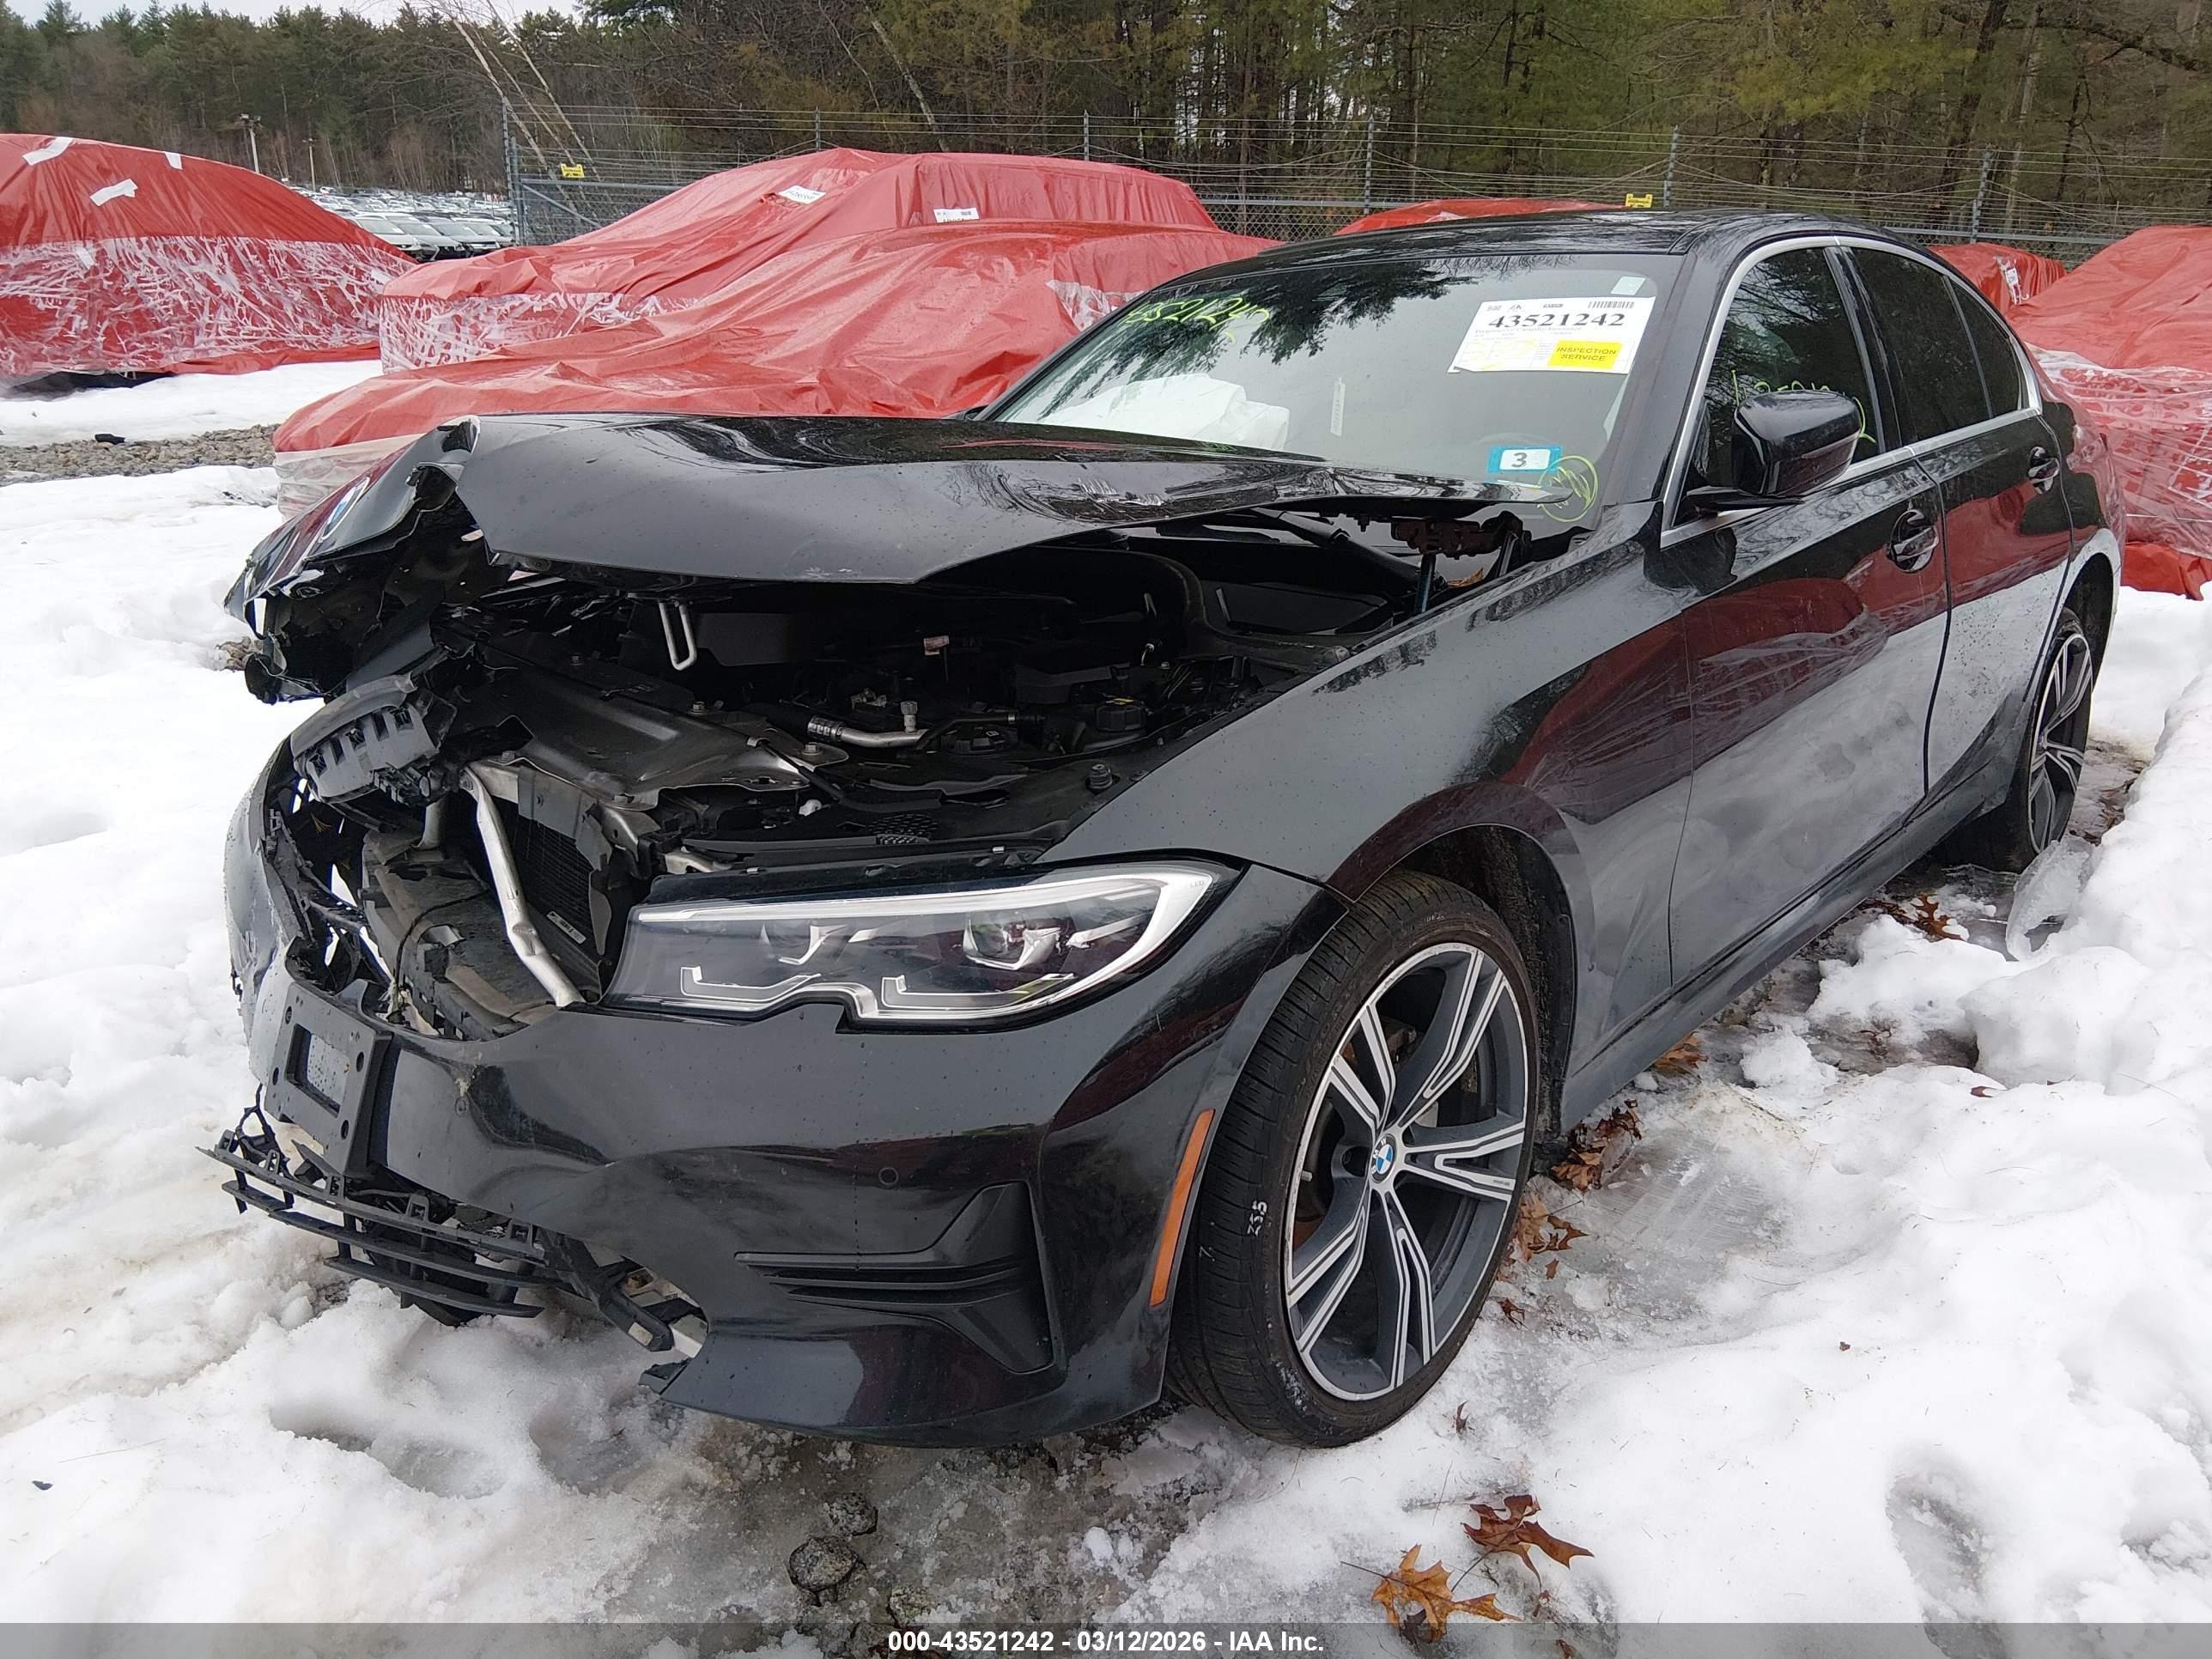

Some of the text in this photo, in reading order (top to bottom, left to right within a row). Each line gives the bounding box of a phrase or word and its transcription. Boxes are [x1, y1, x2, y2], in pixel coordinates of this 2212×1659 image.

[1488, 313, 1626, 328] 43521242
[1511, 452, 1528, 467] 3
[1371, 1138, 1387, 1175] BMW
